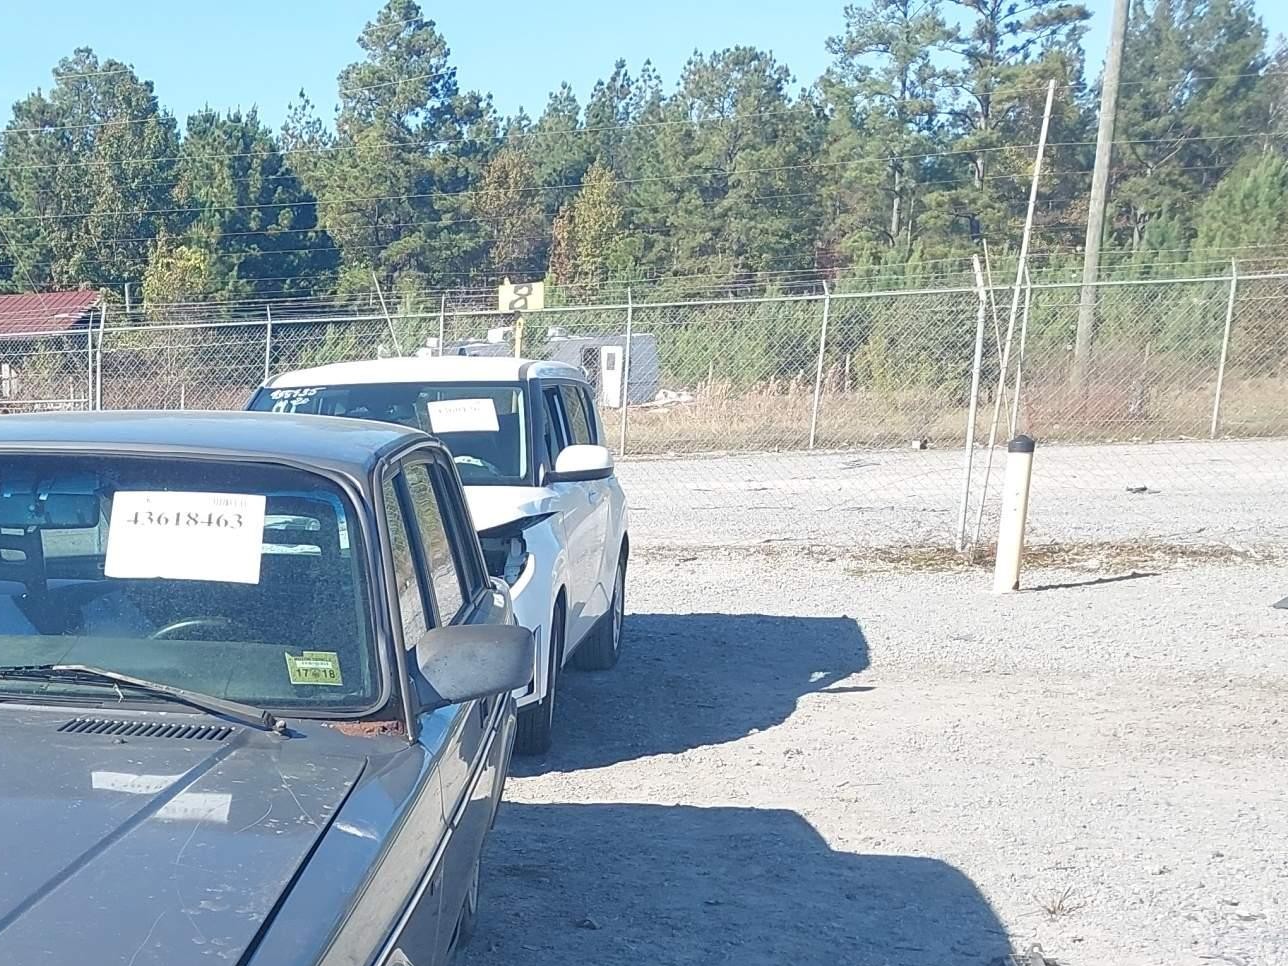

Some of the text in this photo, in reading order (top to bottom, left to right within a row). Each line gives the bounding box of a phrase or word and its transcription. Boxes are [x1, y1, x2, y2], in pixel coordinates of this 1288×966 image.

[509, 284, 533, 310] 8
[126, 511, 244, 529] 43618463
[296, 668, 335, 679] 17 18
